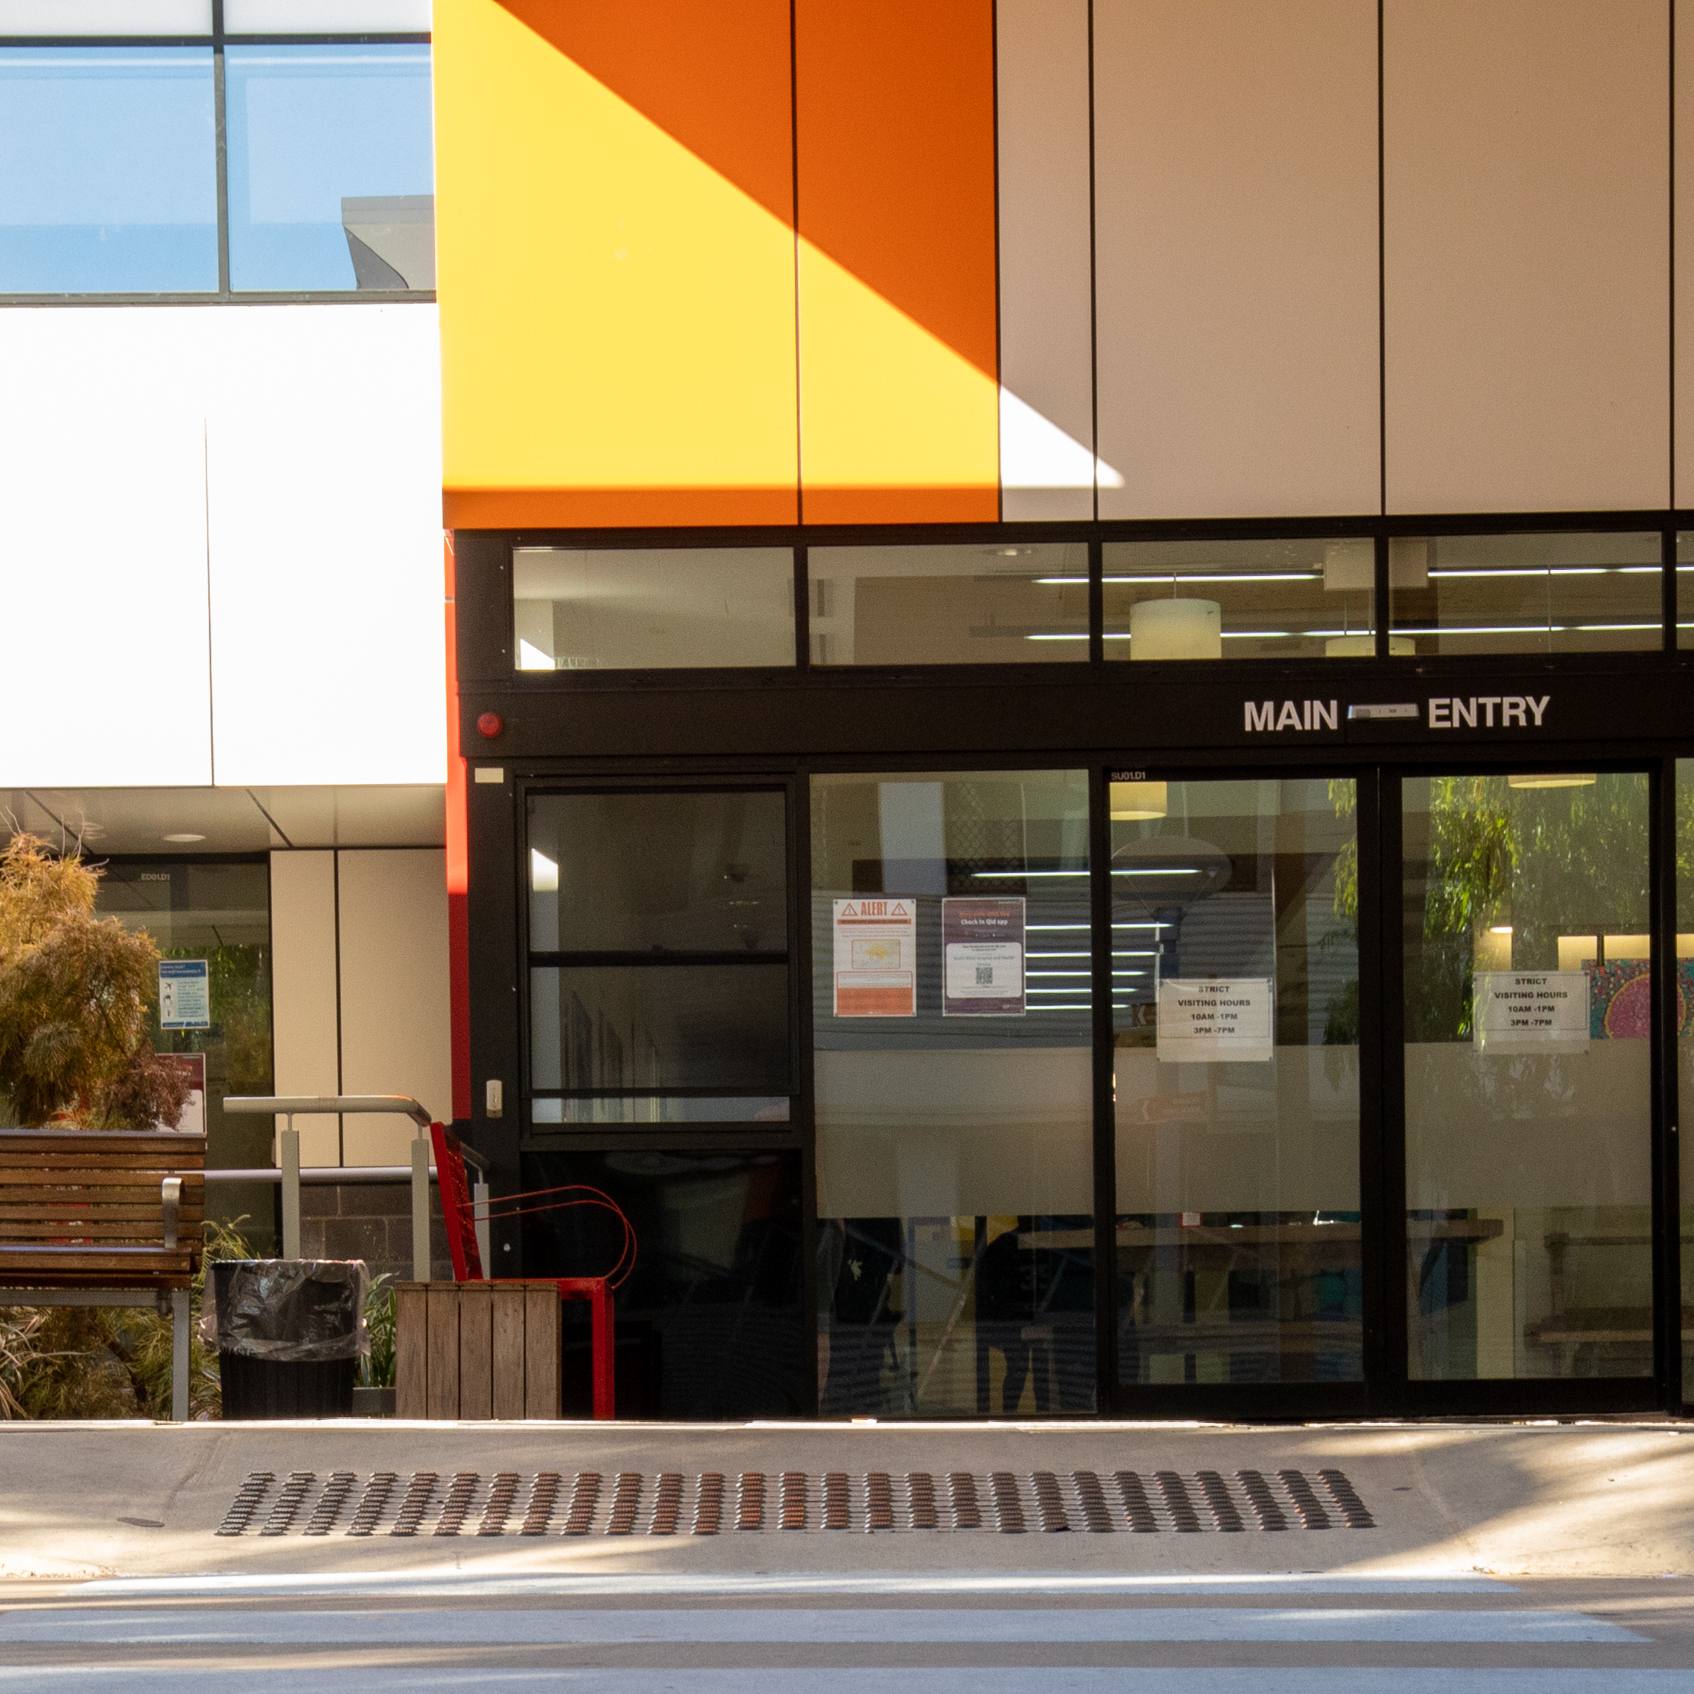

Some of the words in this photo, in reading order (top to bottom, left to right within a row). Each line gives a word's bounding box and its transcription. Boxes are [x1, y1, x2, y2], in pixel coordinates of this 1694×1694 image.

[1244, 700, 1338, 731] MAIN
[1428, 696, 1550, 728] ENTRY
[861, 901, 888, 916] ALERT
